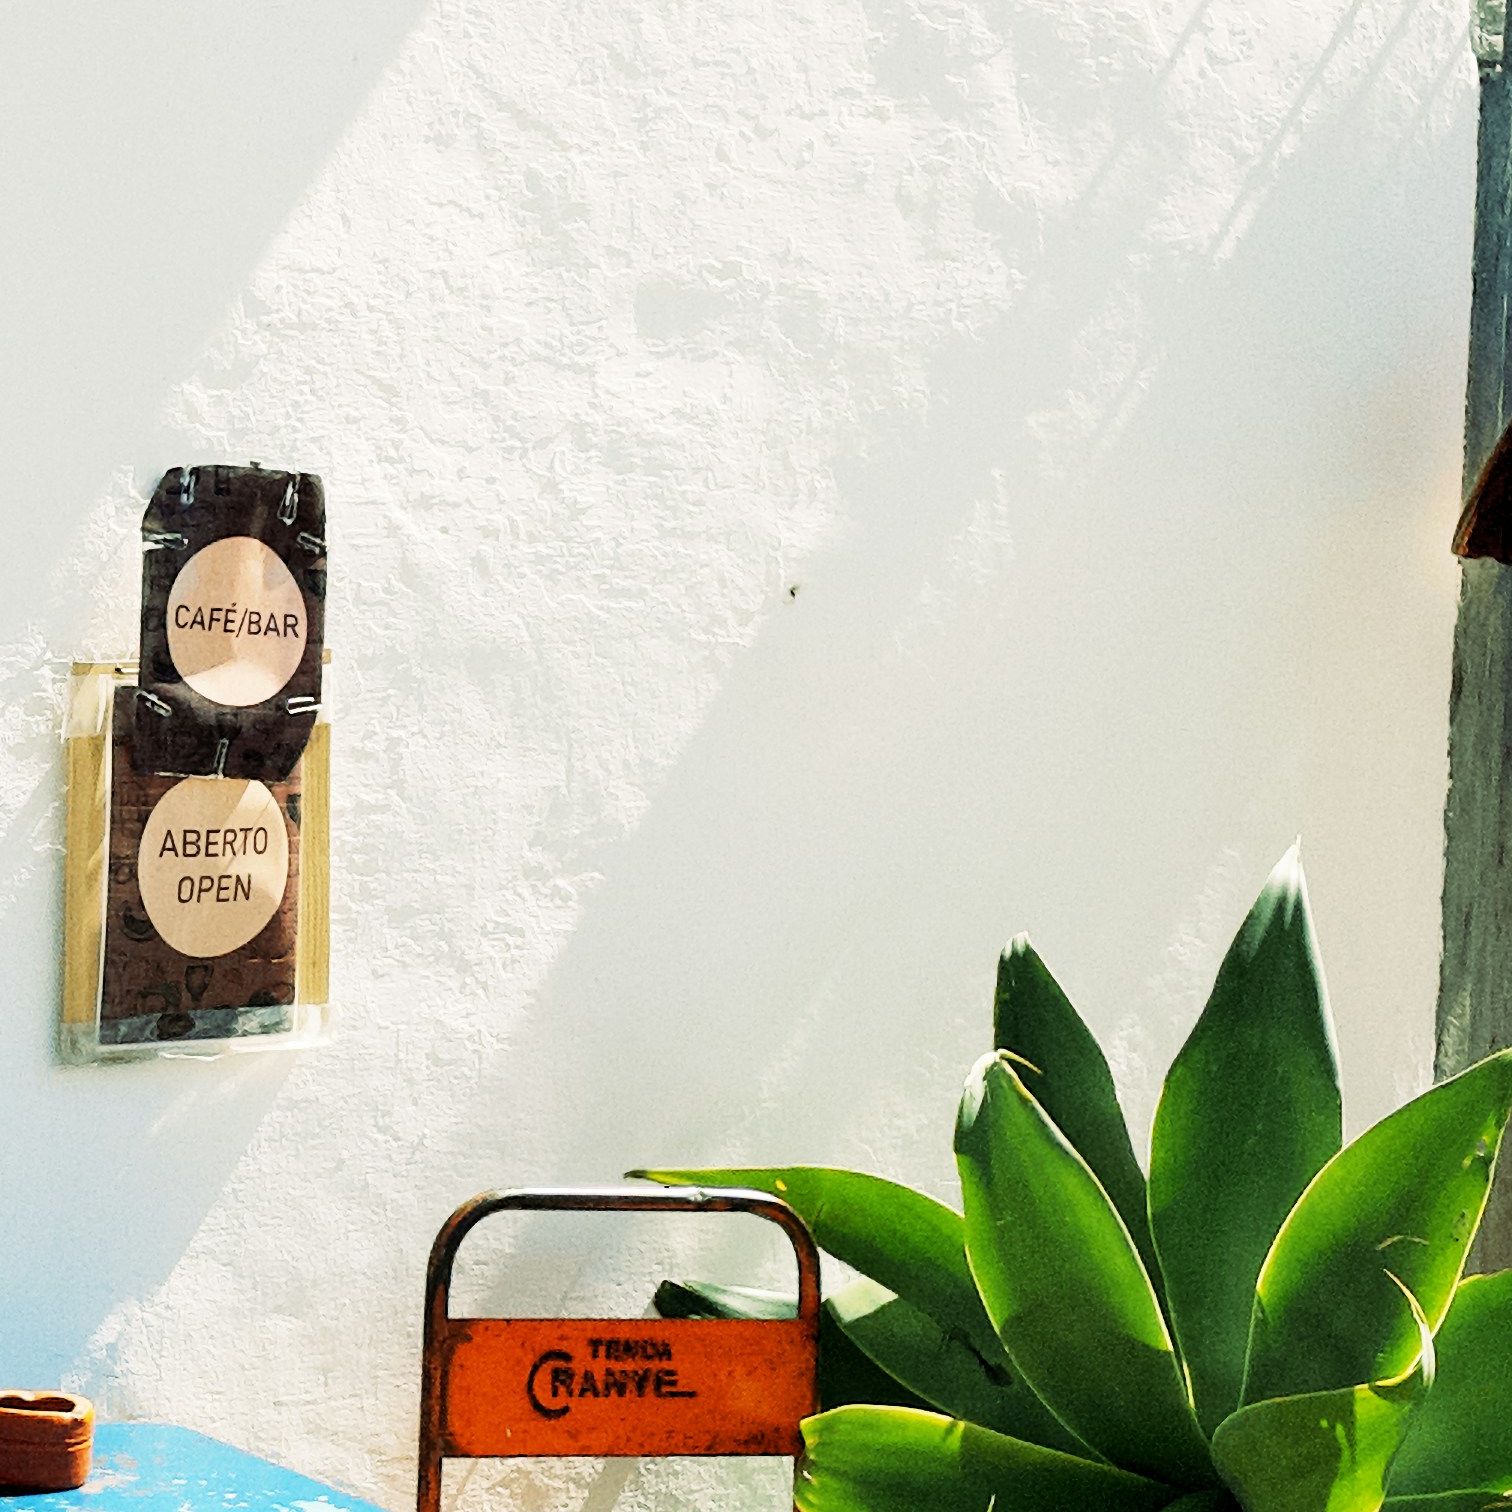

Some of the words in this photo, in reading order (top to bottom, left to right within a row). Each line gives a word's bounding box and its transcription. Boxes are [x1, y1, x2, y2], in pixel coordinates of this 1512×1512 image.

[174, 602, 299, 639] CAFÉ/BAR
[158, 826, 268, 858] ABERTO
[177, 873, 252, 903] OPEN
